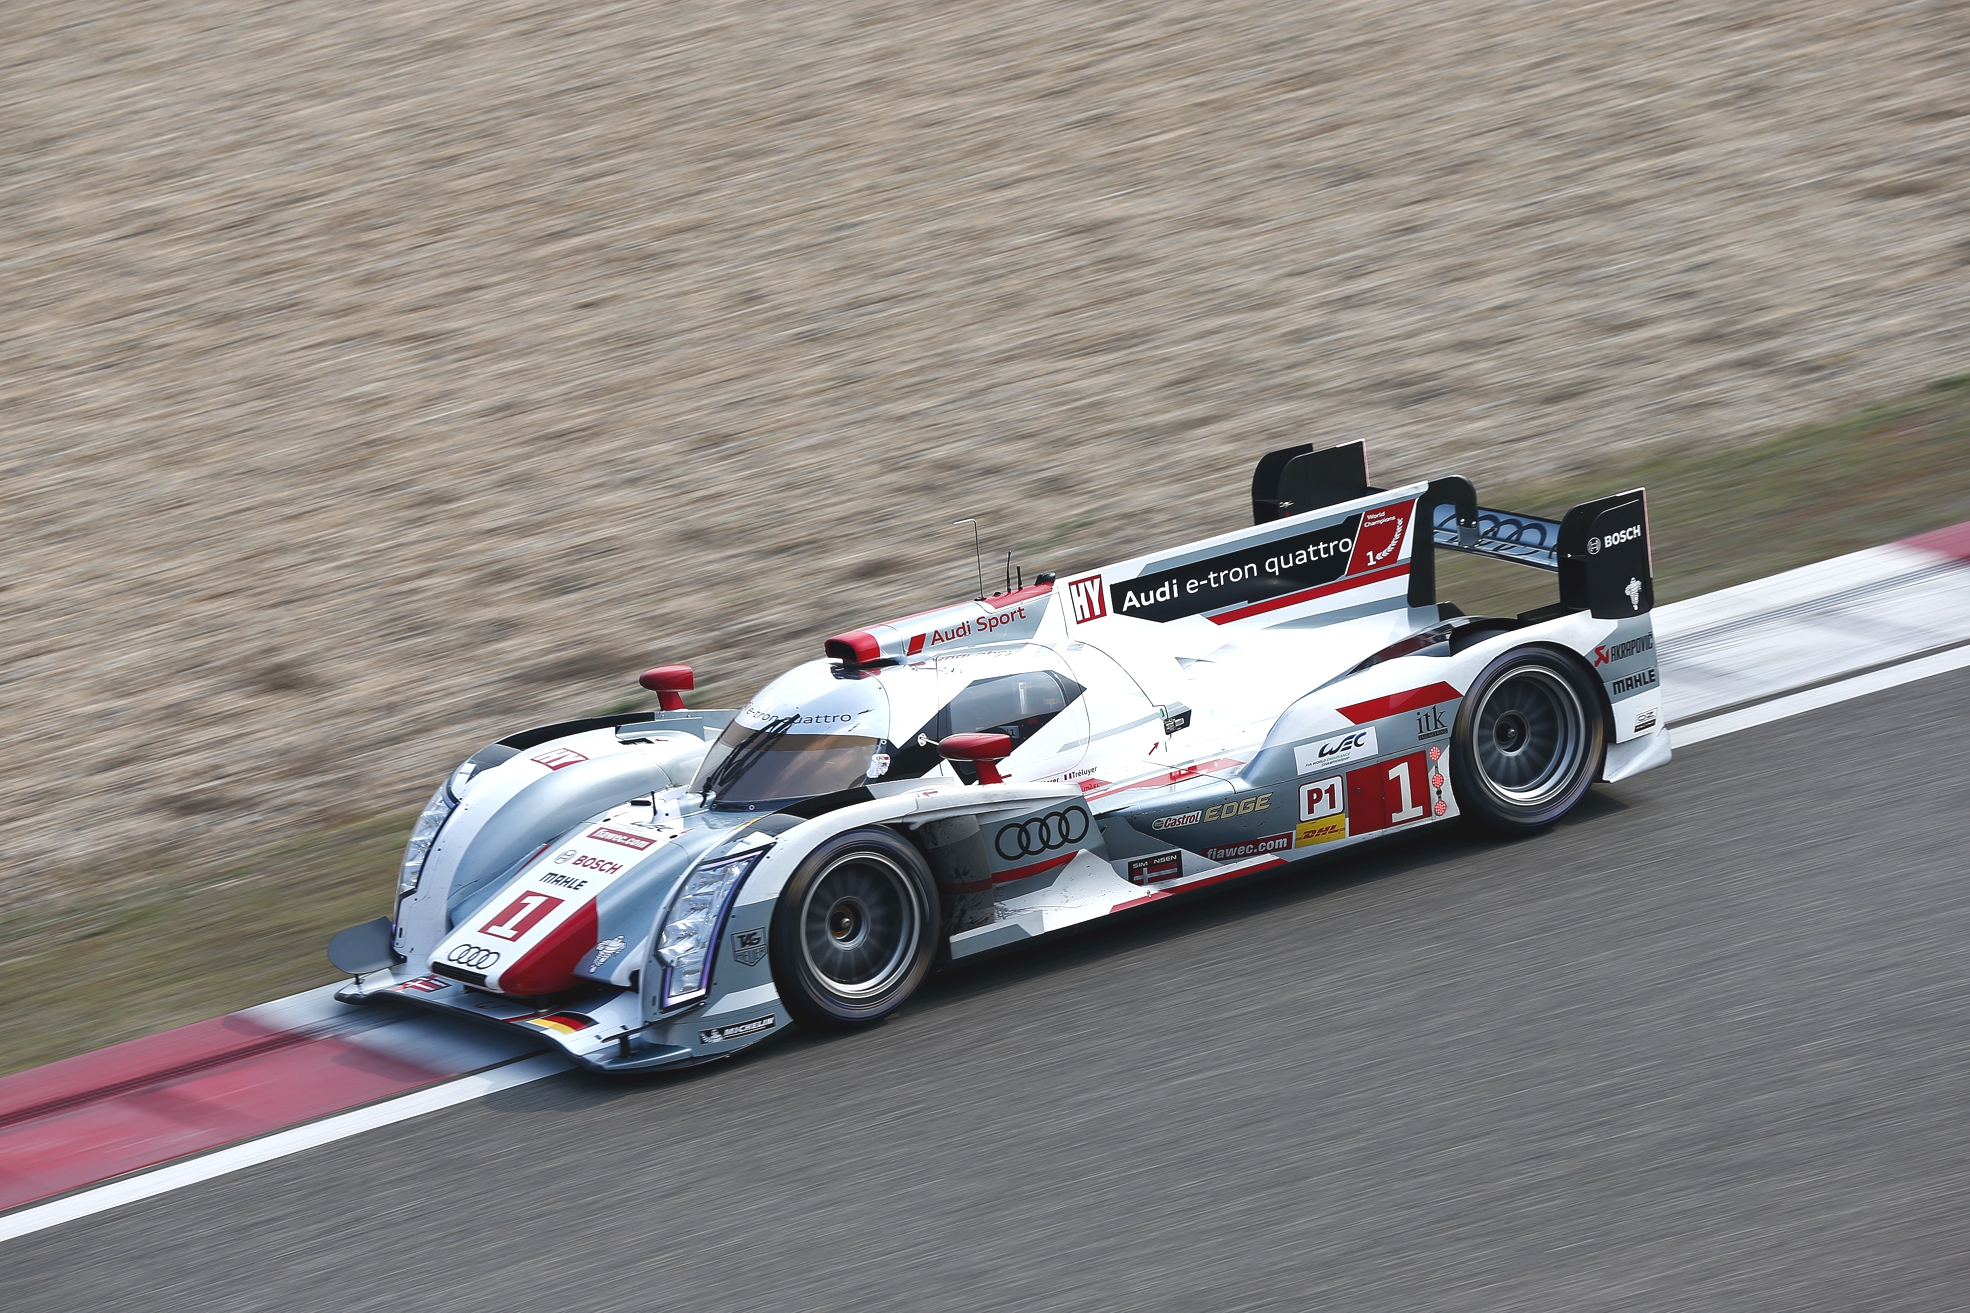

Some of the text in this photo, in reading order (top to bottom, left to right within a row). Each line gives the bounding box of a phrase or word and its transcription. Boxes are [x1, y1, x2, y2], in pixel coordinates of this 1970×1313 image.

[1364, 516, 1396, 528] Champions
[1367, 511, 1386, 520] World
[1604, 524, 1641, 548] BOSCH
[1366, 550, 1377, 566] 1
[1122, 537, 1352, 611] Audi e-tron quattro
[1070, 577, 1102, 622] HY
[931, 606, 1027, 646] Audi Sport
[1612, 669, 1656, 695] MAHLE
[1416, 704, 1447, 735] itk
[1318, 731, 1367, 758] WEC
[1307, 783, 1336, 815] P1
[1388, 761, 1424, 823] 1
[1163, 791, 1275, 828] Castrol EDGE
[1303, 824, 1339, 840] DHL
[1206, 837, 1288, 860] fiawec.com
[572, 855, 624, 875] BOSCH
[539, 872, 589, 891] MAHLE
[485, 895, 549, 939] 1
[737, 931, 761, 949] TAG
